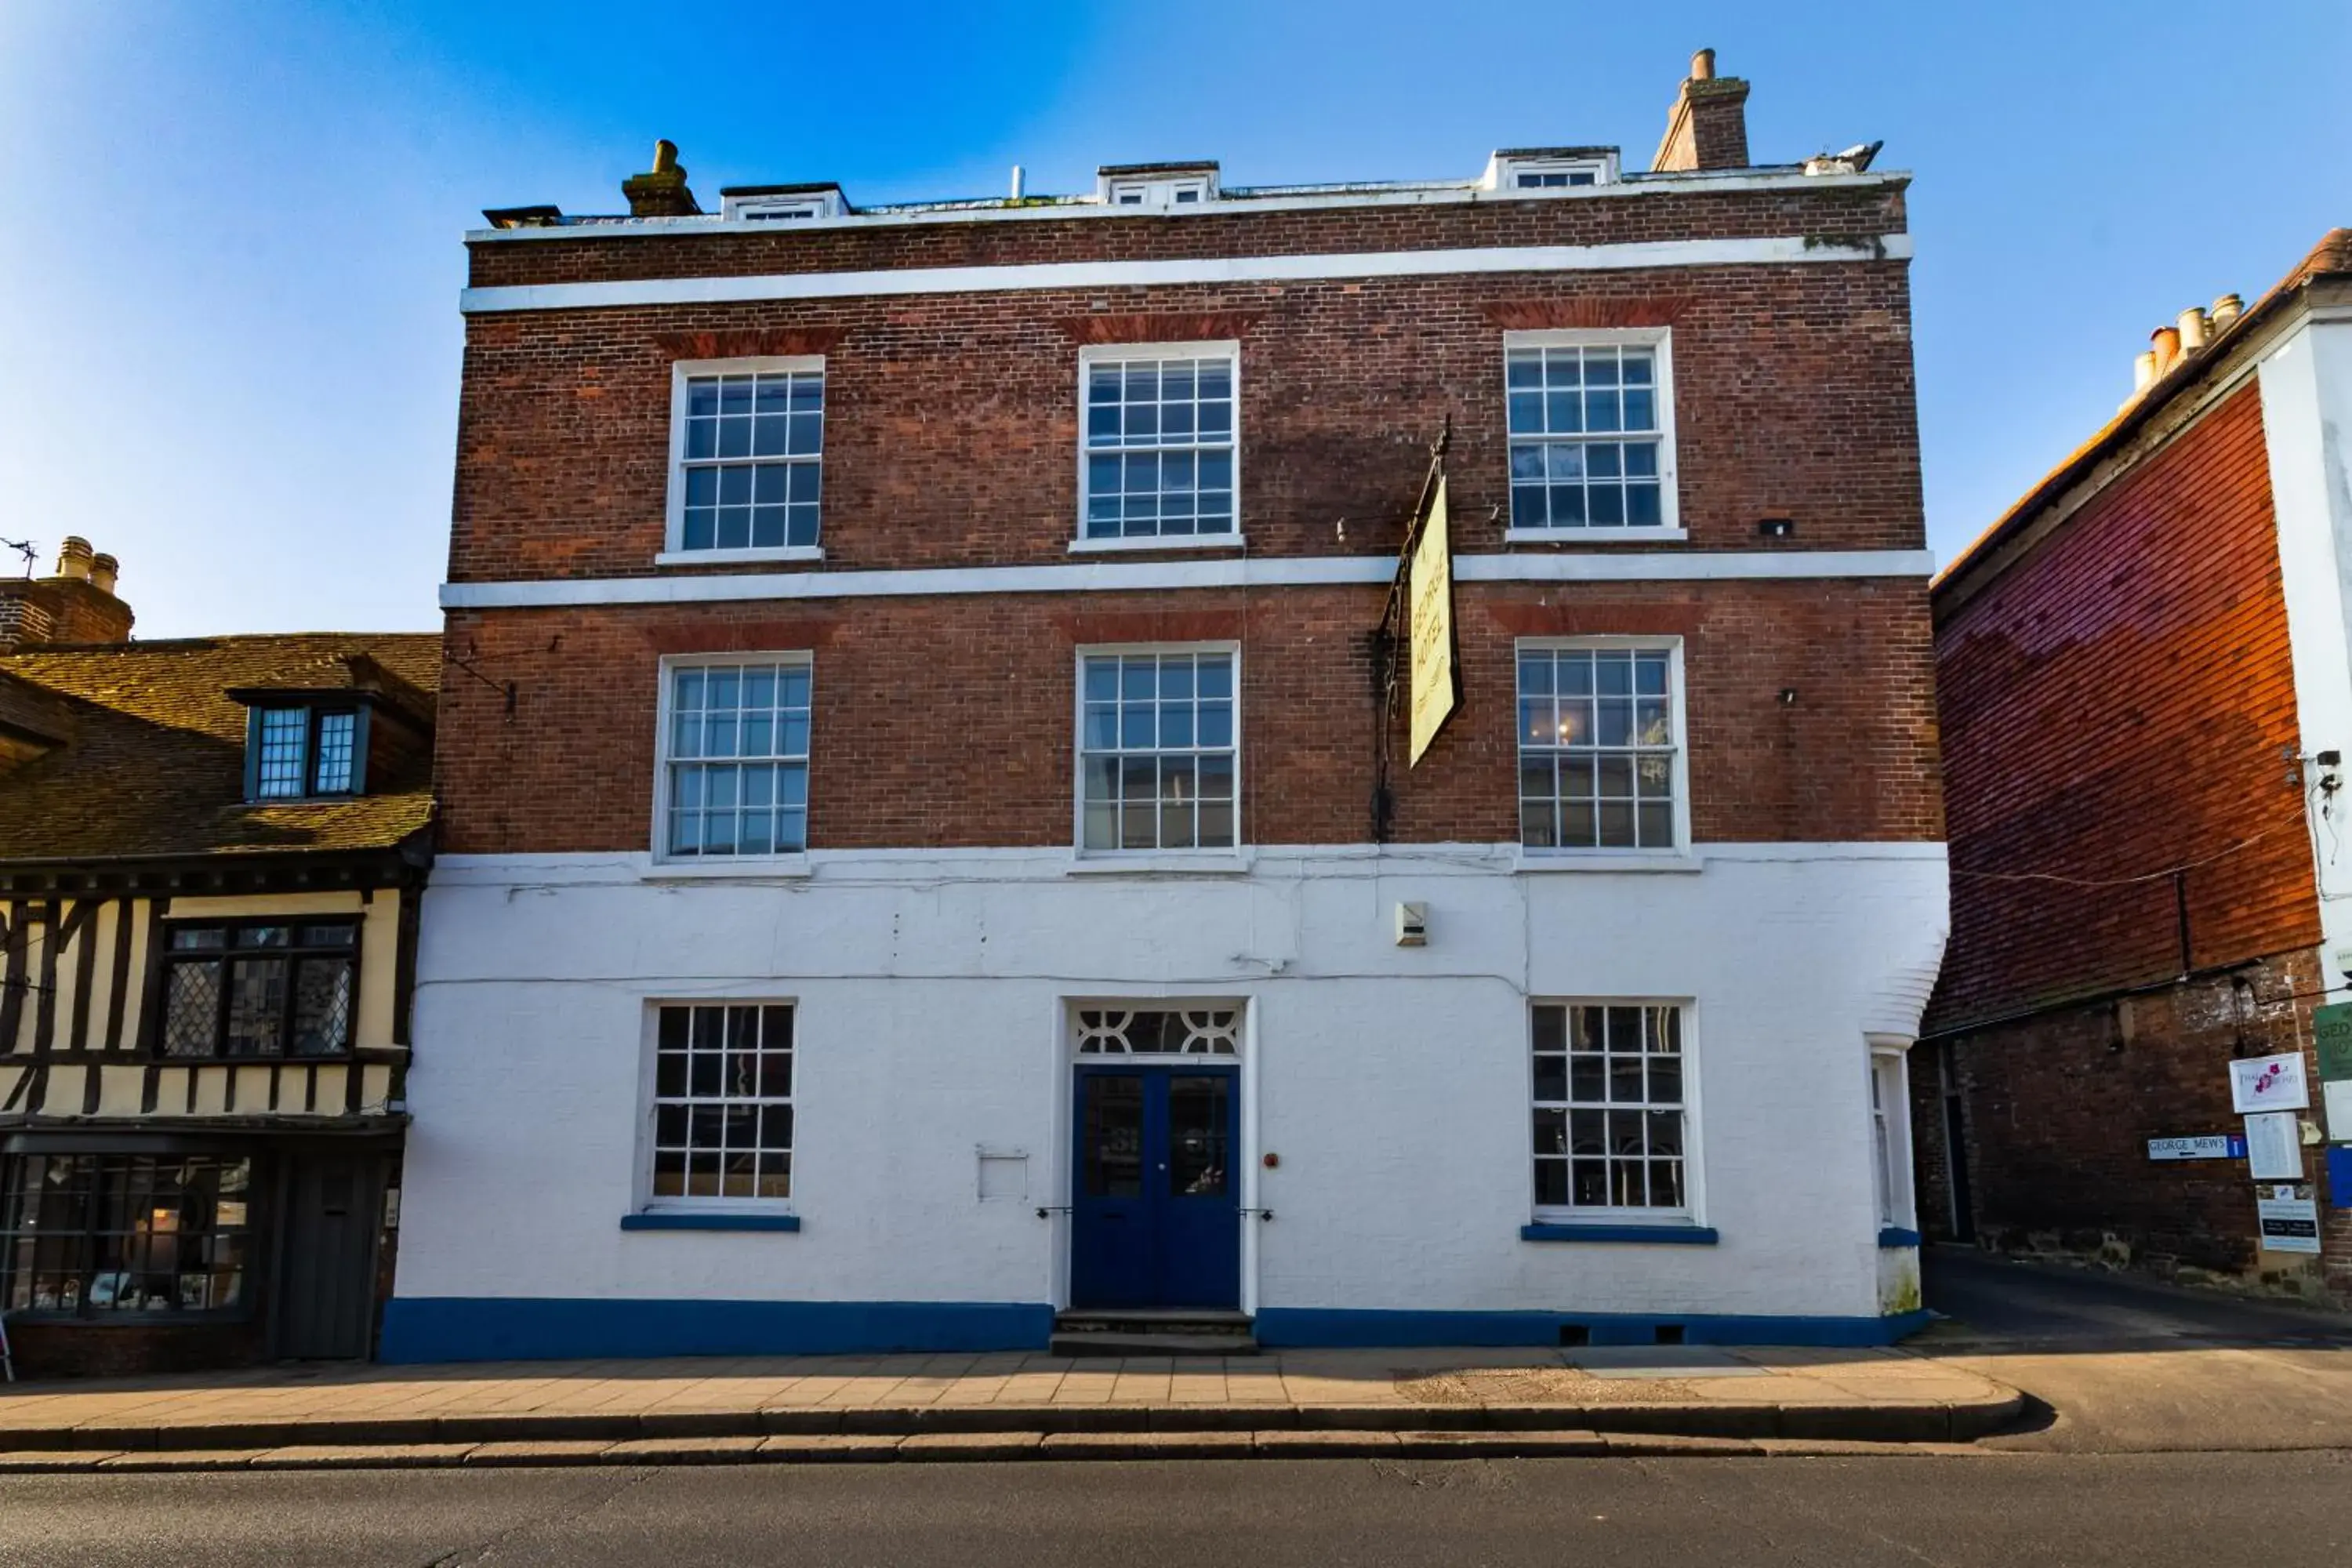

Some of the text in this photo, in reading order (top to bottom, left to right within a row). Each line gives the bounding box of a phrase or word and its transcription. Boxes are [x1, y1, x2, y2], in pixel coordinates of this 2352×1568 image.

[1417, 611, 1442, 676] HOTEL
[2149, 1138, 2225, 1152] GEORGE MEWS
